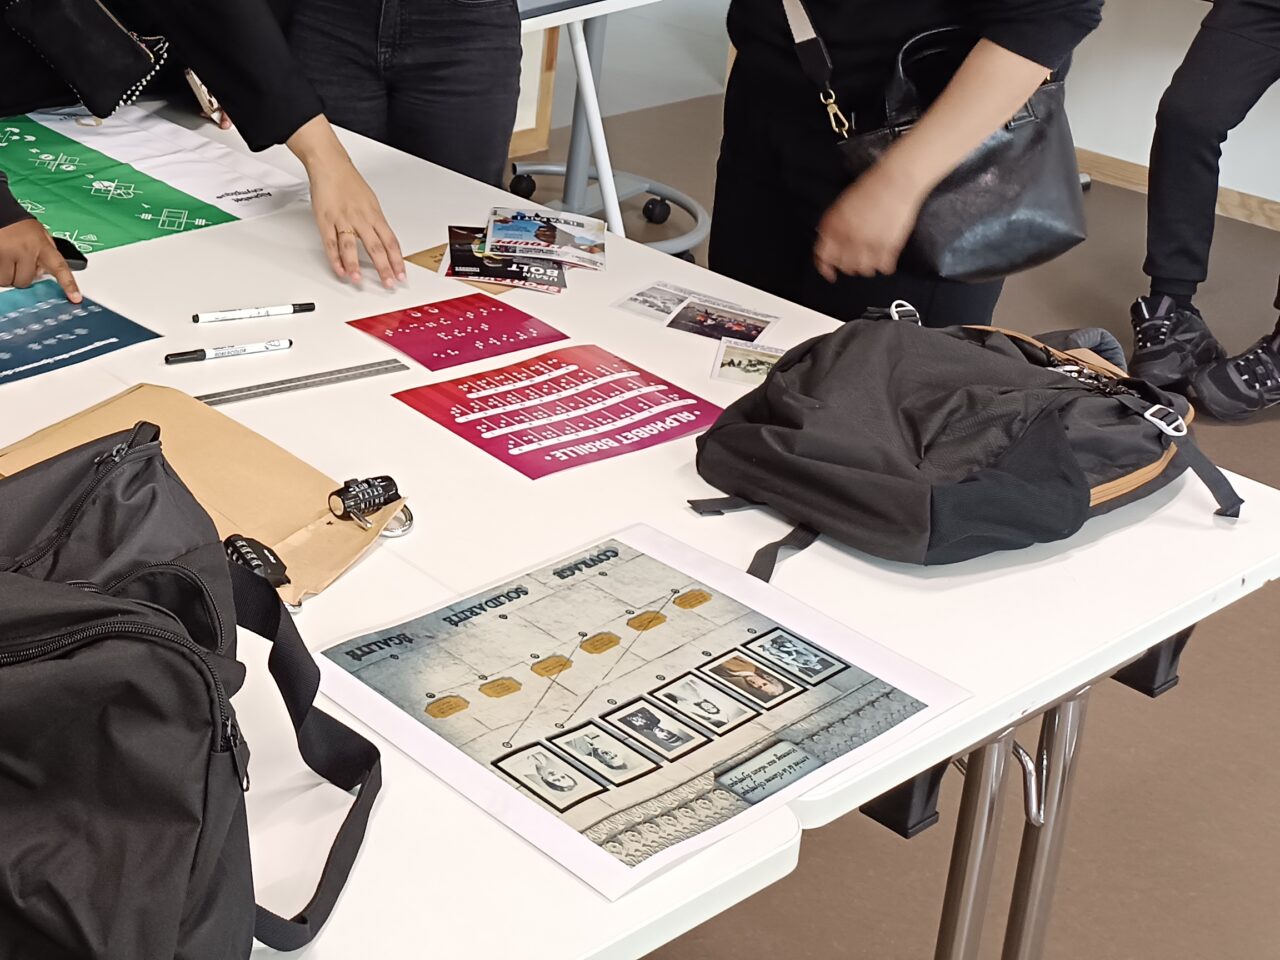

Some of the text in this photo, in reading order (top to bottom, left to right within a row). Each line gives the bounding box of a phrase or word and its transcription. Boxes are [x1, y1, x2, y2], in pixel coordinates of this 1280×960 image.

[506, 263, 560, 277] BOLT
[522, 271, 558, 282] USAIN
[614, 410, 697, 444] ALPHABET
[549, 437, 621, 461] BRAILLE
[442, 584, 529, 628] SOLIDARITÉ
[344, 631, 415, 662] ÉGALITÉ
